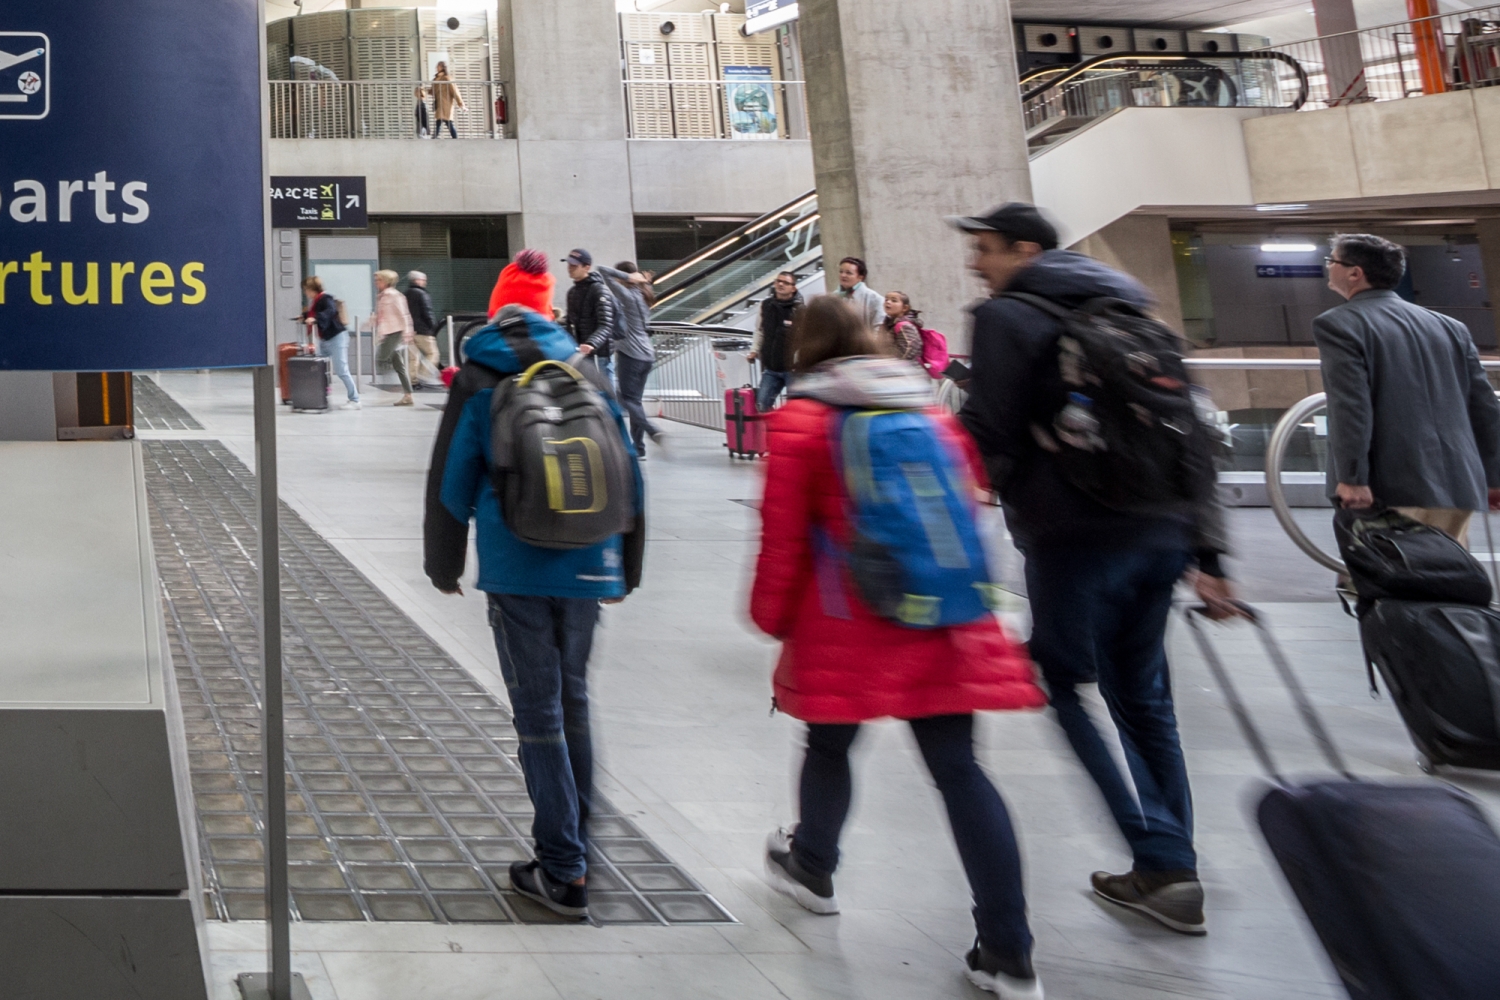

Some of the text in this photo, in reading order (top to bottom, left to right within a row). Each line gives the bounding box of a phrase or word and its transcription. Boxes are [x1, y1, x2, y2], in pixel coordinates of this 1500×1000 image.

[269, 188, 318, 199] 2A 2C 2E
[300, 207, 319, 215] Taxis
